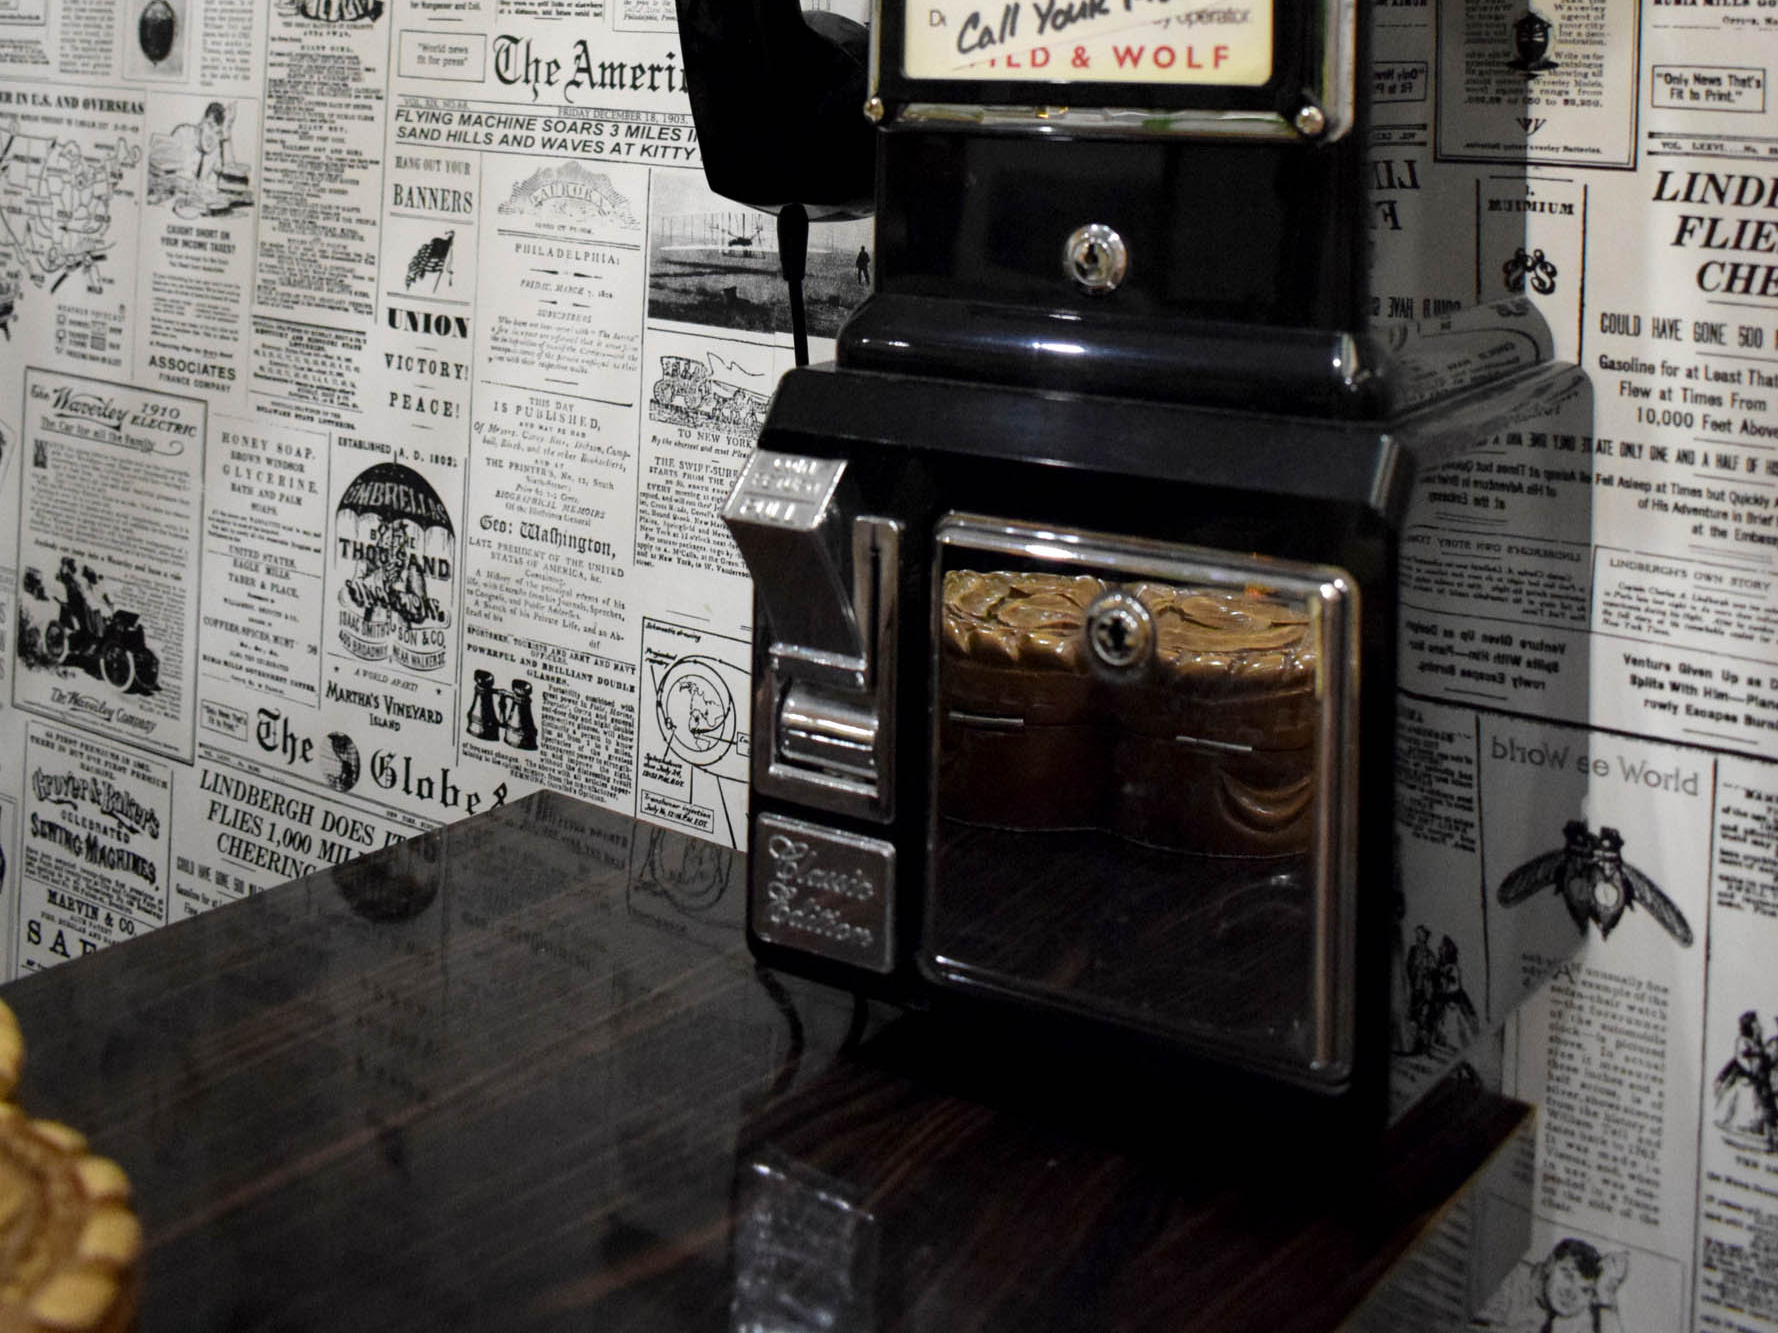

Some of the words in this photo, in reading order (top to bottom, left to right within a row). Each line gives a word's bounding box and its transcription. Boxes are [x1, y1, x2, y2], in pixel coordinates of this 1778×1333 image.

[956, 2, 1020, 54] Call
[493, 34, 562, 103] The
[564, 39, 690, 104] Ameri
[1071, 46, 1091, 68] &
[1112, 46, 1230, 68] WOLF
[1669, 87, 1686, 101] Fit
[1689, 89, 1701, 101] to
[1694, 73, 1723, 88] News
[394, 108, 454, 126] FLYING
[458, 112, 537, 132] MACHINE
[542, 117, 604, 137] SOARS
[609, 123, 619, 138] 3
[624, 124, 682, 143] MILES
[396, 126, 441, 142] SAND
[446, 129, 493, 146] HILLS
[499, 134, 535, 150] AND
[541, 137, 605, 155] WAVES
[609, 141, 635, 157] AT
[639, 144, 697, 162] KITTY
[392, 183, 474, 215] BANNERS
[386, 306, 470, 339] UNION
[1600, 313, 1641, 337] COULD
[1652, 318, 1682, 342] HAVE
[1693, 322, 1727, 346] GONE
[1739, 326, 1763, 348] 500
[384, 352, 469, 381] VICTORY!
[1599, 355, 1655, 376] Gasoline
[1661, 361, 1679, 377] for
[1685, 366, 1699, 380] at
[1704, 365, 1741, 385] Least
[1749, 369, 1778, 389] That
[389, 391, 460, 419] PEACE!
[1620, 380, 1651, 399] Flew
[1659, 386, 1673, 402] at
[1682, 389, 1723, 408] Times
[1731, 392, 1766, 411] From
[1637, 407, 1693, 429] 10,000
[1702, 414, 1733, 433] Feet
[256, 707, 314, 766] The
[370, 748, 481, 815] Globe
[1617, 754, 1700, 798] World
[199, 769, 314, 826] LINDBERGH
[321, 810, 375, 846] DOES
